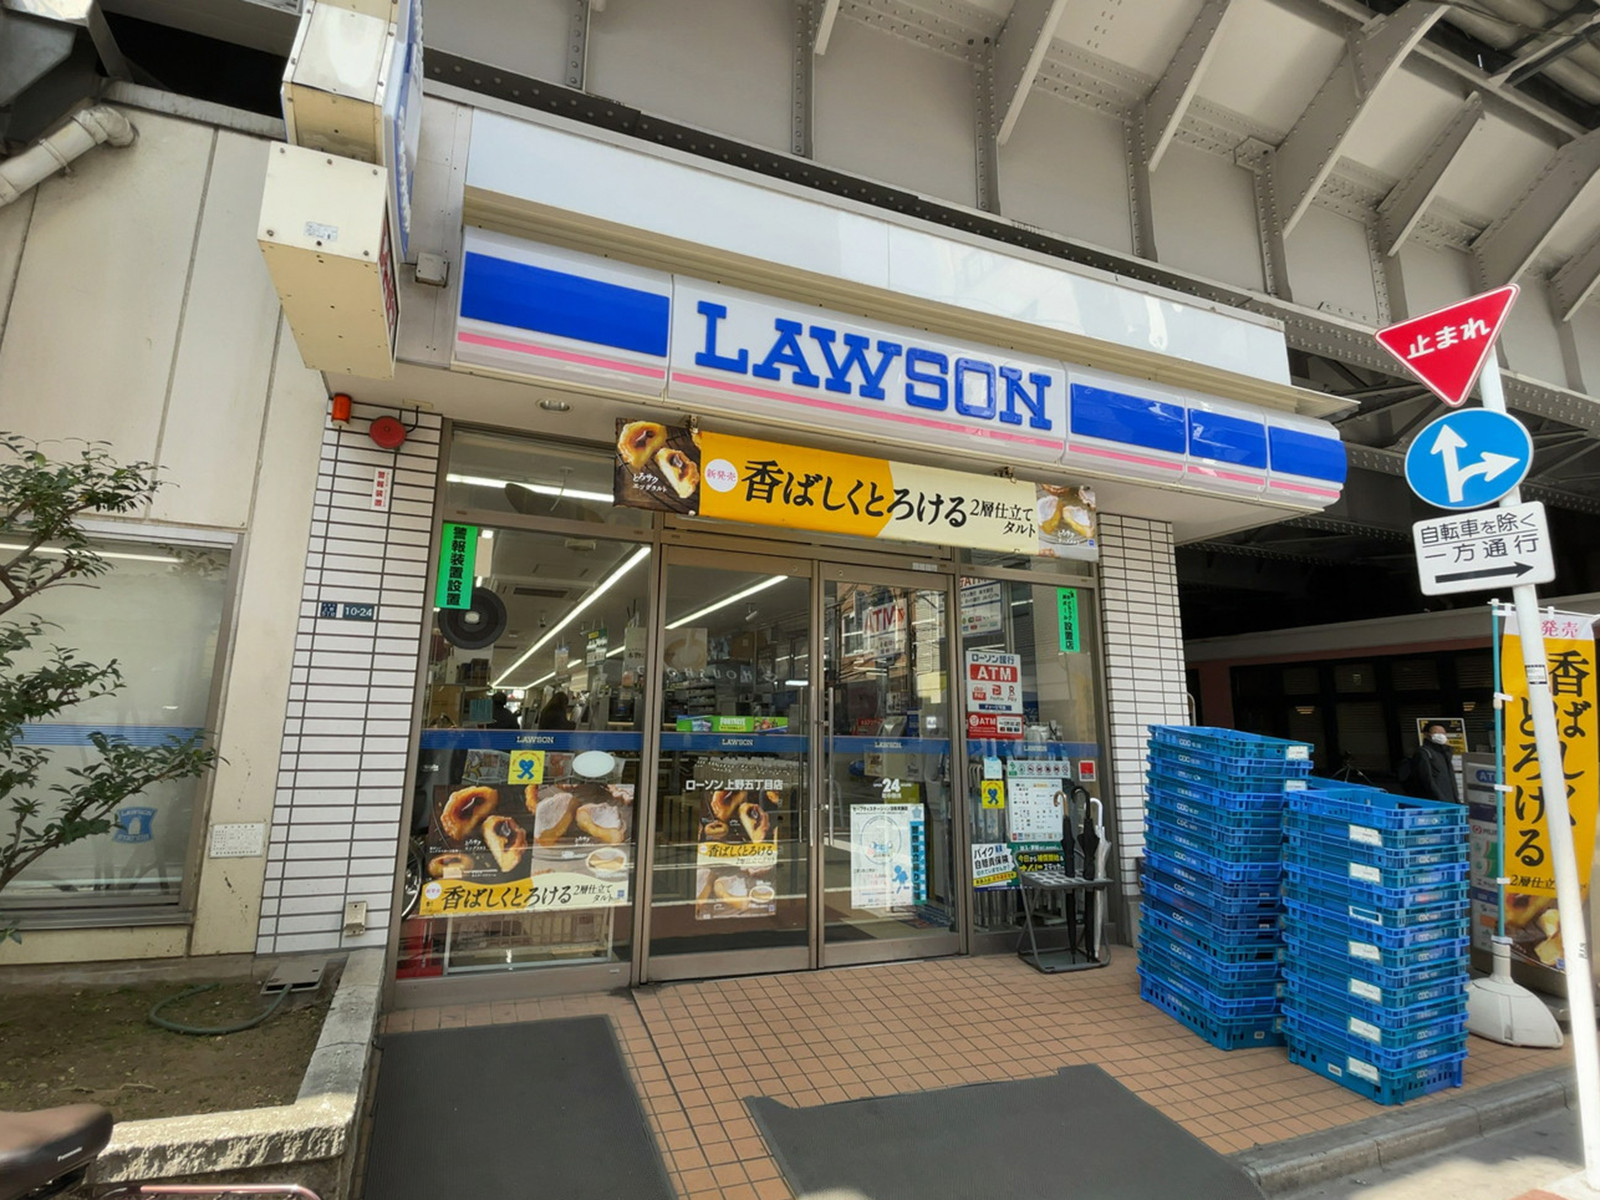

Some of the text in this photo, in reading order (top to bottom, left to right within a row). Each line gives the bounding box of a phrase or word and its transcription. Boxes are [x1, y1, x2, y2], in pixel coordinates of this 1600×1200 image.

[1407, 317, 1491, 359] 止まれ
[695, 300, 1052, 431] LAWSON
[706, 467, 736, 482] 新発売
[741, 459, 967, 528] 香ばしくとろける
[970, 498, 1034, 523] 2層仕立て
[1003, 520, 1036, 538] タルト
[1420, 512, 1537, 545] 自転車を除く
[1424, 533, 1539, 563] 一方通行
[345, 606, 373, 617] 10-24
[977, 665, 1012, 681] ATM
[516, 735, 554, 744] LAWSON
[721, 738, 754, 746] LAWSON
[685, 779, 784, 791] ローソン 上野五丁目店
[882, 777, 901, 793] 24
[974, 846, 994, 859] バイク
[442, 884, 571, 911] 香ばしくとろける
